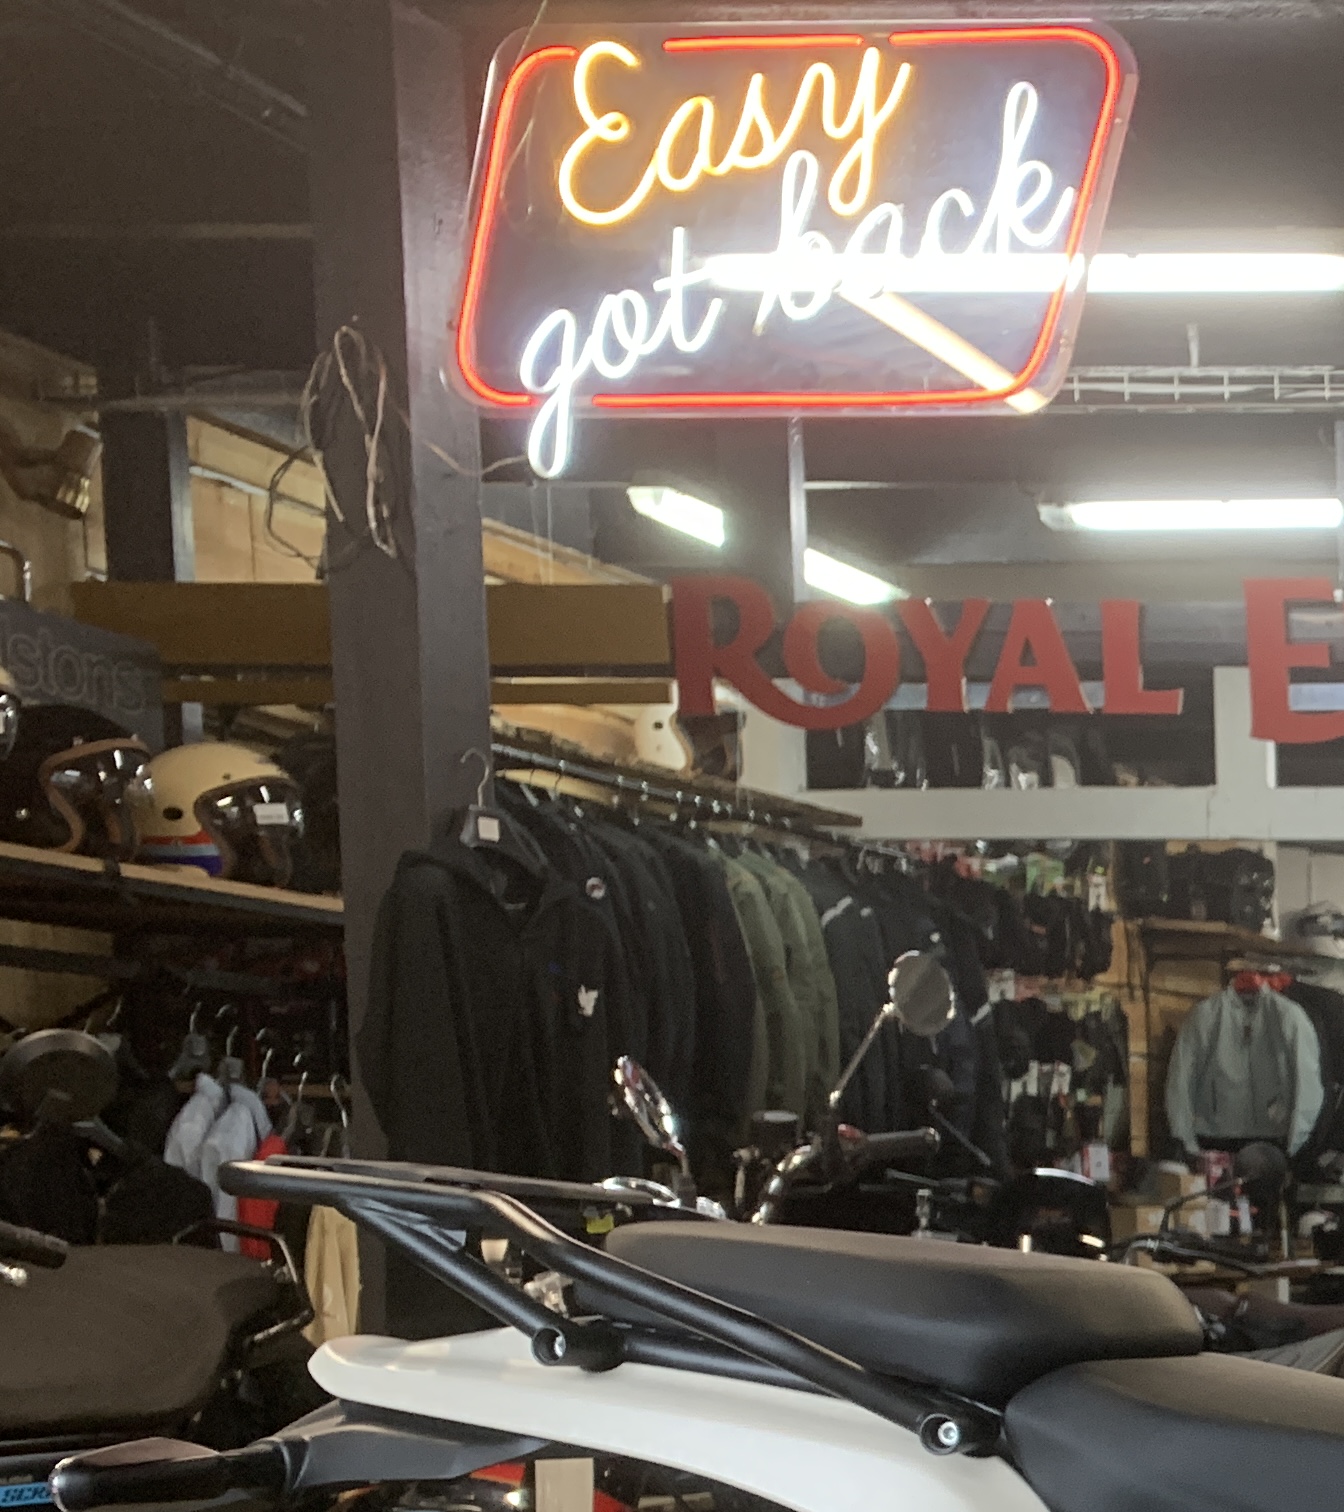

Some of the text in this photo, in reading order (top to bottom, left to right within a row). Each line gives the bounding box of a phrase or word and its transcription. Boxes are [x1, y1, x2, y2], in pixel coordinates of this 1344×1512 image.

[556, 39, 912, 226] Easy
[519, 80, 1077, 481] got back
[670, 573, 1184, 730] ROYAL
